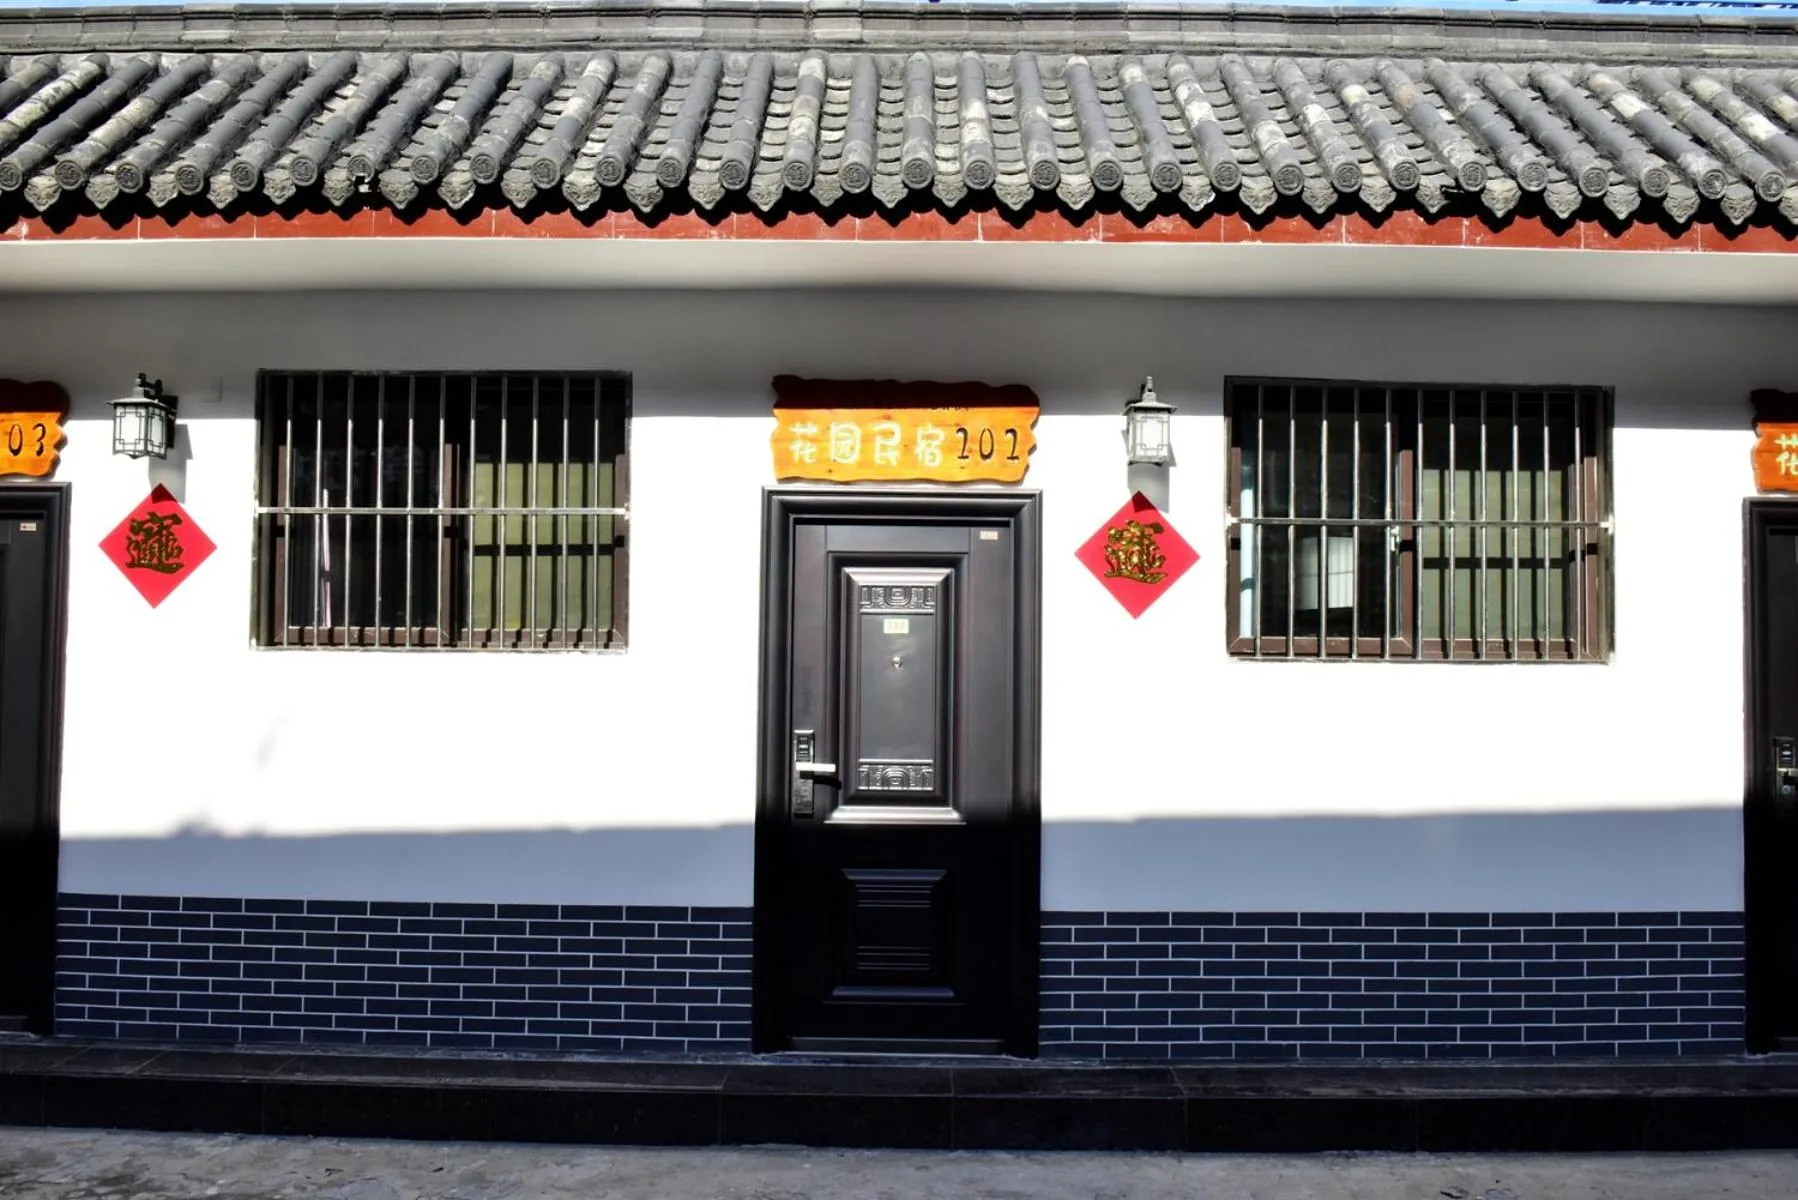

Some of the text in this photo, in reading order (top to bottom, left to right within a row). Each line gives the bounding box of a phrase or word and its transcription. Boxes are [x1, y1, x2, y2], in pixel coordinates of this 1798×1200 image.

[789, 421, 1020, 467] 花园民宿 202
